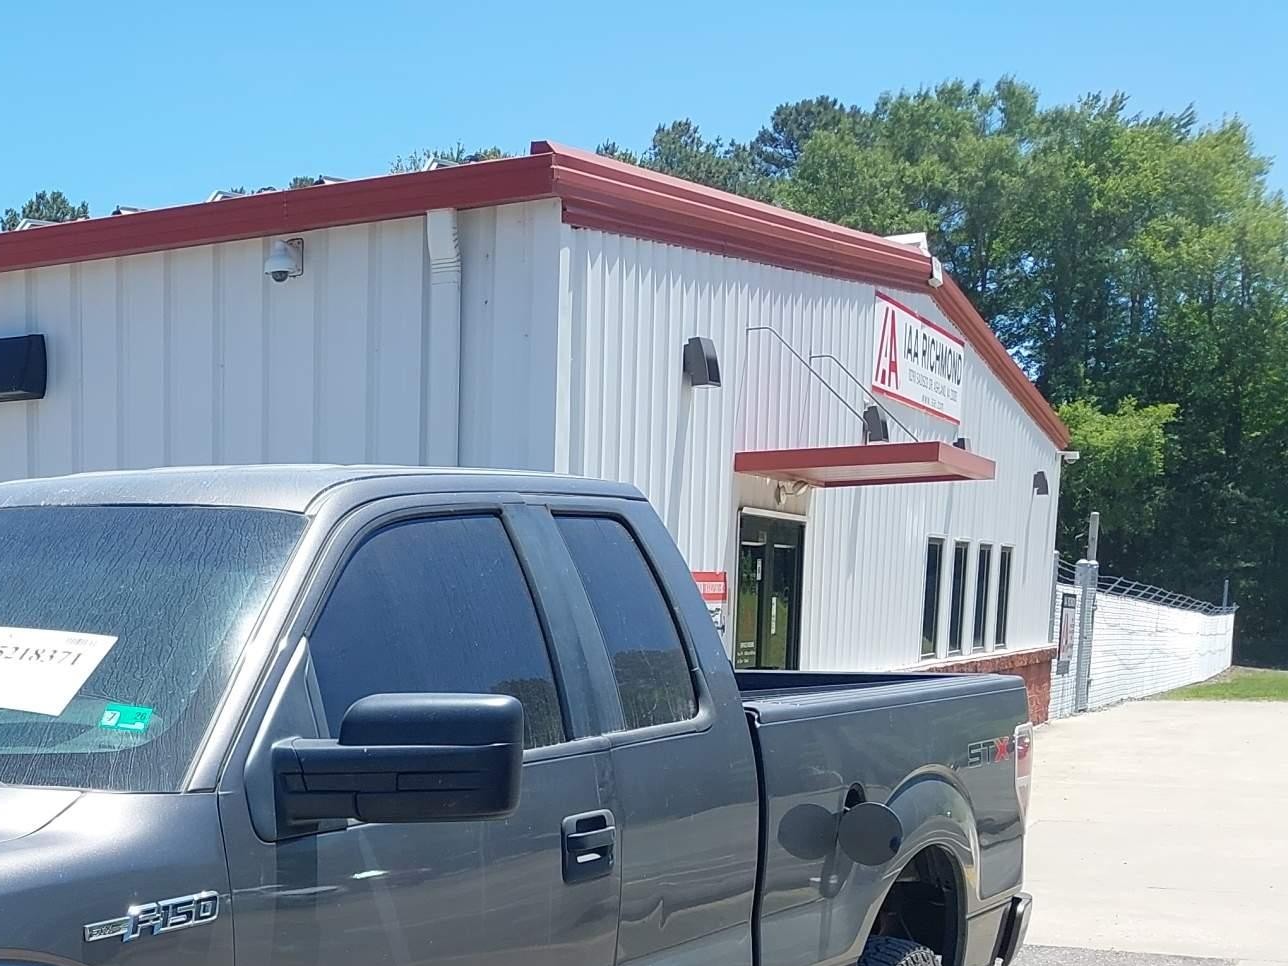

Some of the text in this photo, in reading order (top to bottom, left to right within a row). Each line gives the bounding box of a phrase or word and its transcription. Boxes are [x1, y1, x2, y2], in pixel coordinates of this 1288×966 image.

[904, 323, 919, 365] IAA
[921, 333, 962, 385] RICHMOND
[967, 736, 1010, 768] STX
